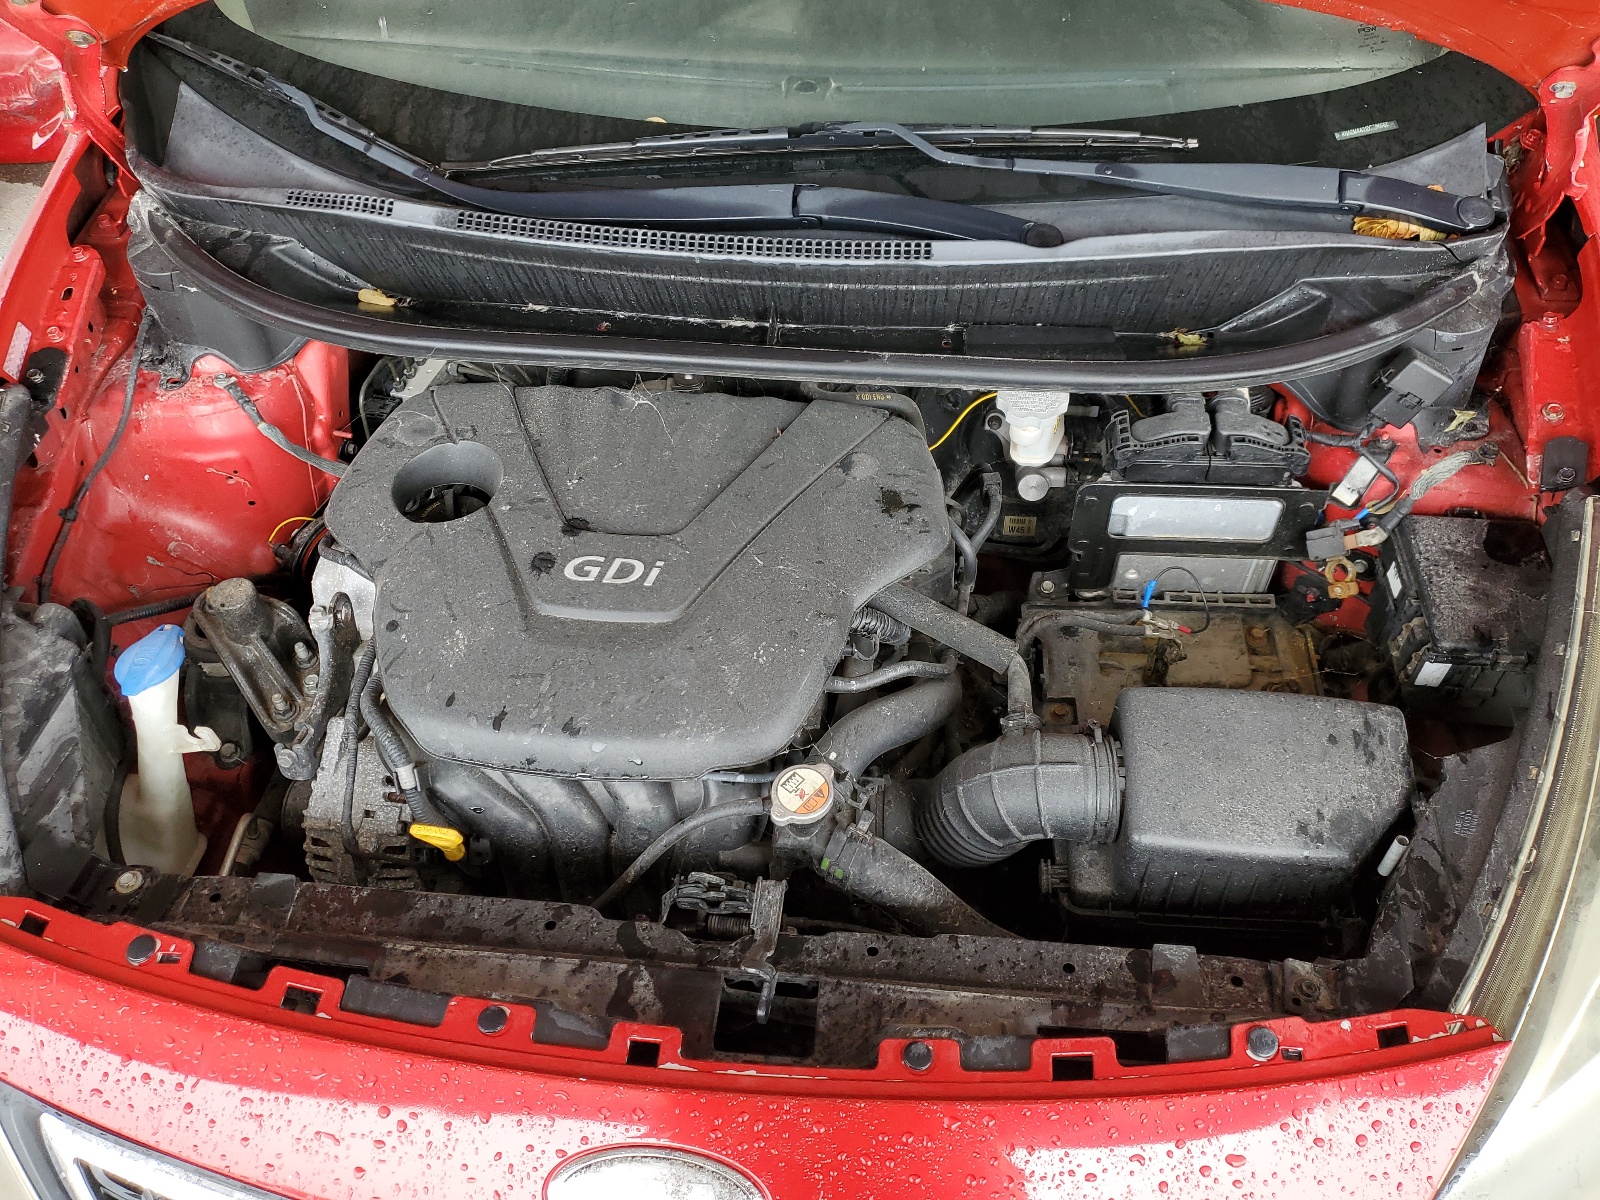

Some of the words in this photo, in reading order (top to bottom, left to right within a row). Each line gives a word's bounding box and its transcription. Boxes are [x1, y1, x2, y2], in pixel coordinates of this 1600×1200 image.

[1357, 25, 1377, 34] PGW
[1008, 525, 1025, 534] W45
[563, 555, 665, 587] GDi
